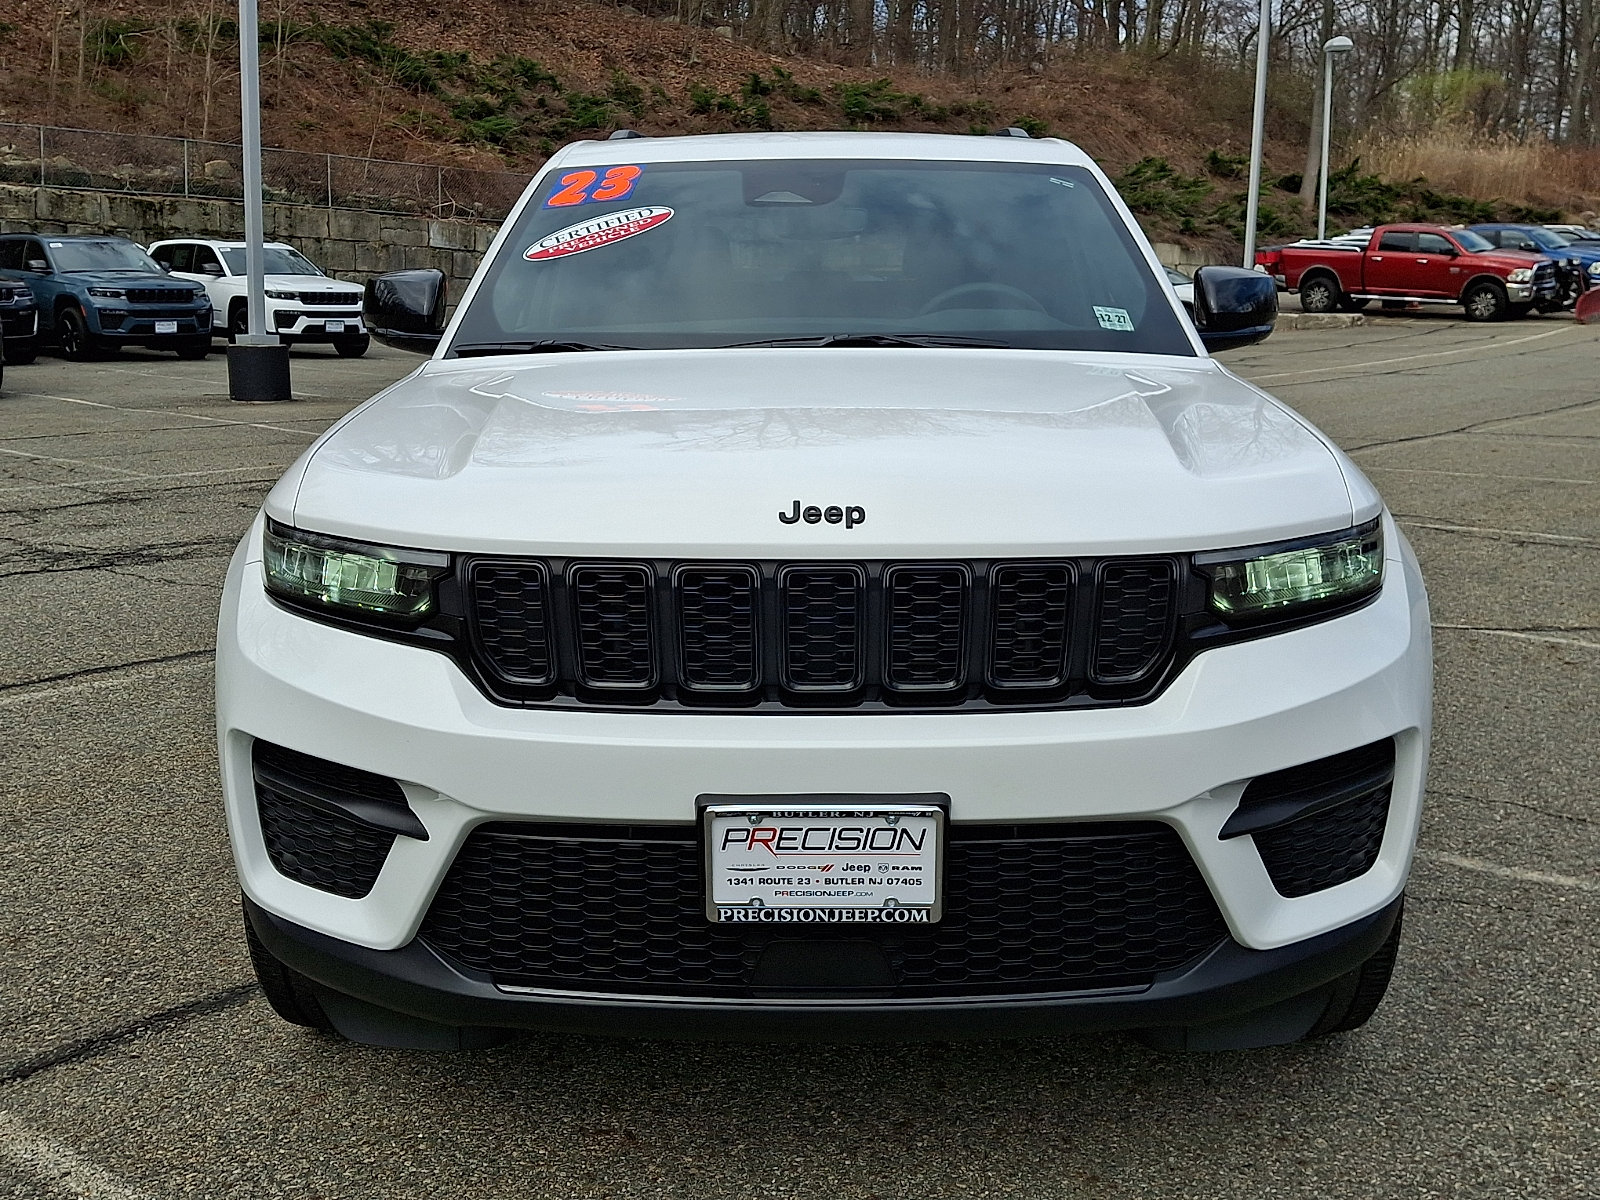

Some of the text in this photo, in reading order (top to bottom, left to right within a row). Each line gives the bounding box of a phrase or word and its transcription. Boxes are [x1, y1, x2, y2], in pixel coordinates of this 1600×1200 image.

[547, 165, 642, 206] 23
[539, 208, 654, 249] CERTIFIED
[548, 217, 653, 254] PRE-OWNED
[565, 224, 640, 251] VEHICLE
[1099, 313, 1127, 324] 12 27
[778, 500, 866, 529] Jeep
[721, 827, 928, 859] PRECISION
[726, 877, 923, 886] 1341 ROUTE 23 BUTLER NJ 07405
[841, 863, 872, 874] Jeep
[719, 908, 929, 923] PRECISIONJEEP.COM
